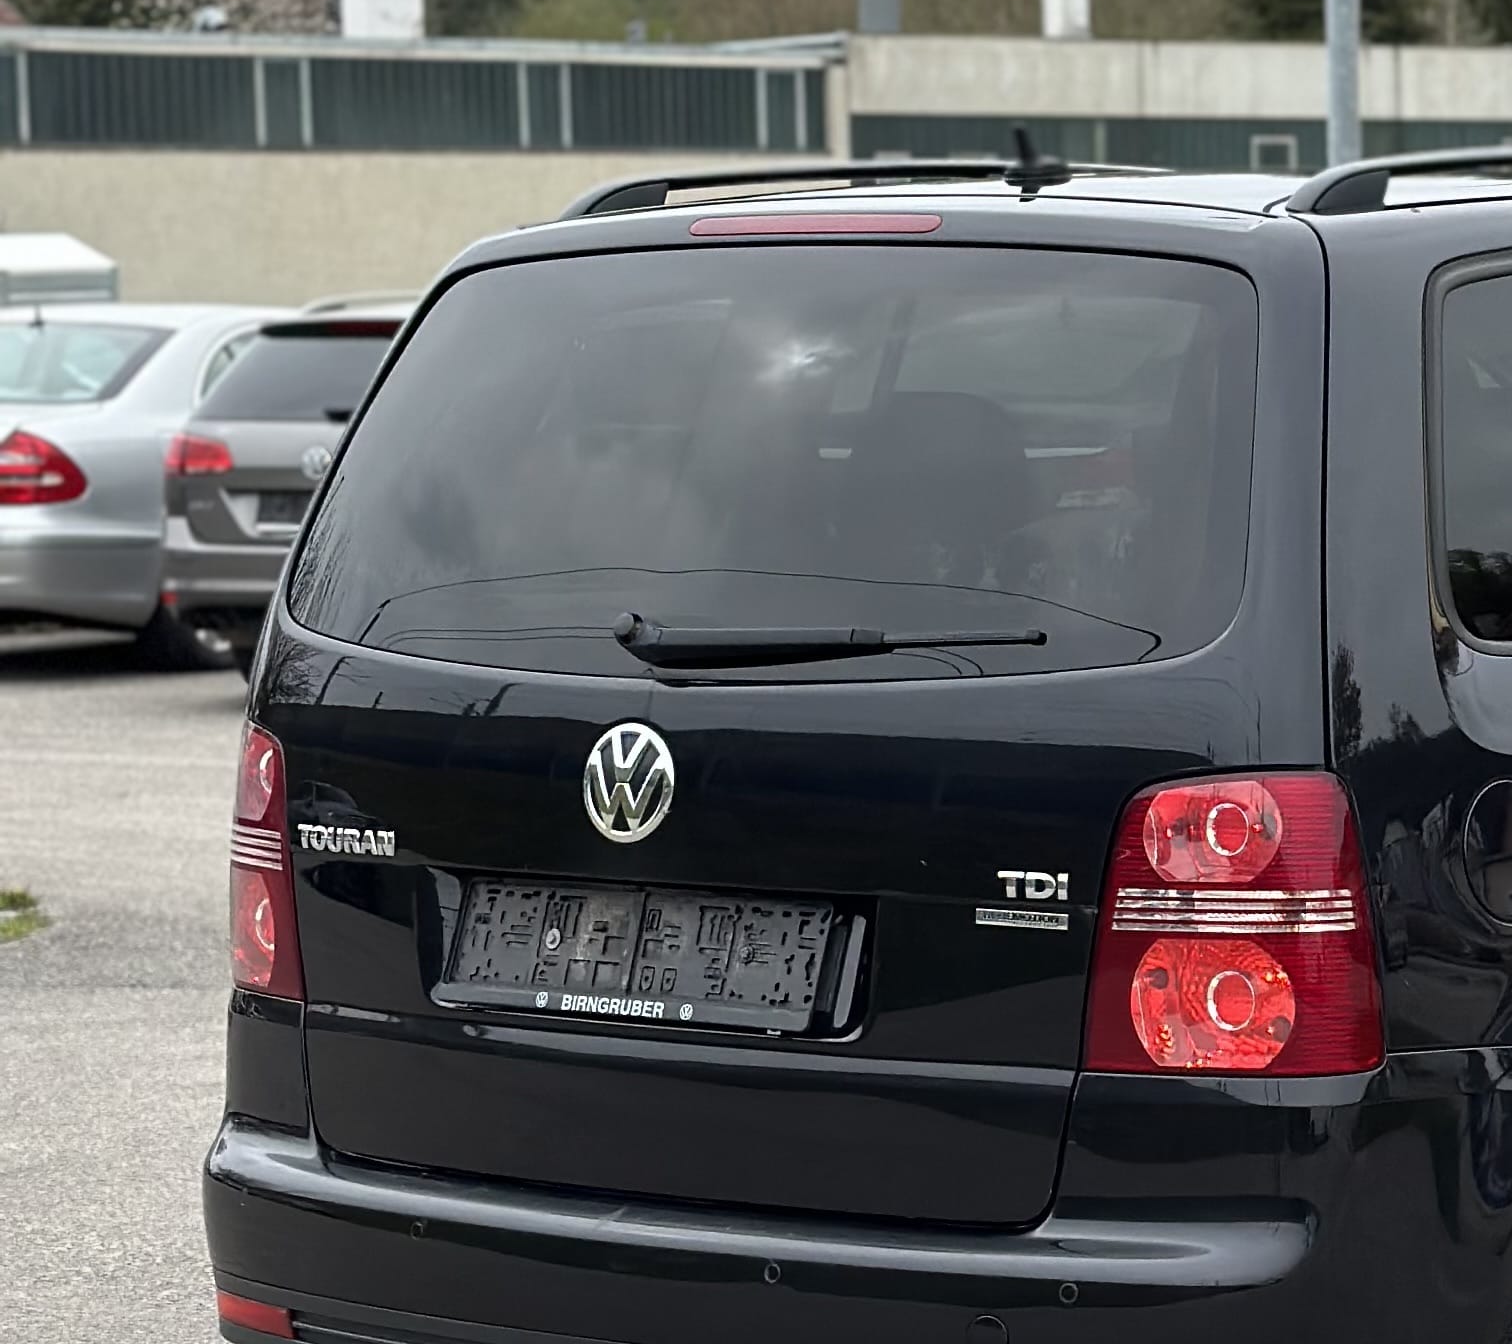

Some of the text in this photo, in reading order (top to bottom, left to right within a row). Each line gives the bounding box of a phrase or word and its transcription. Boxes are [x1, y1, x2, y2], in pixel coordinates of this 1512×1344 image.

[584, 722, 674, 843] VW
[297, 823, 395, 857] TOURAN
[997, 870, 1069, 900] TDI
[560, 994, 665, 1019] BIRNGRUBER
